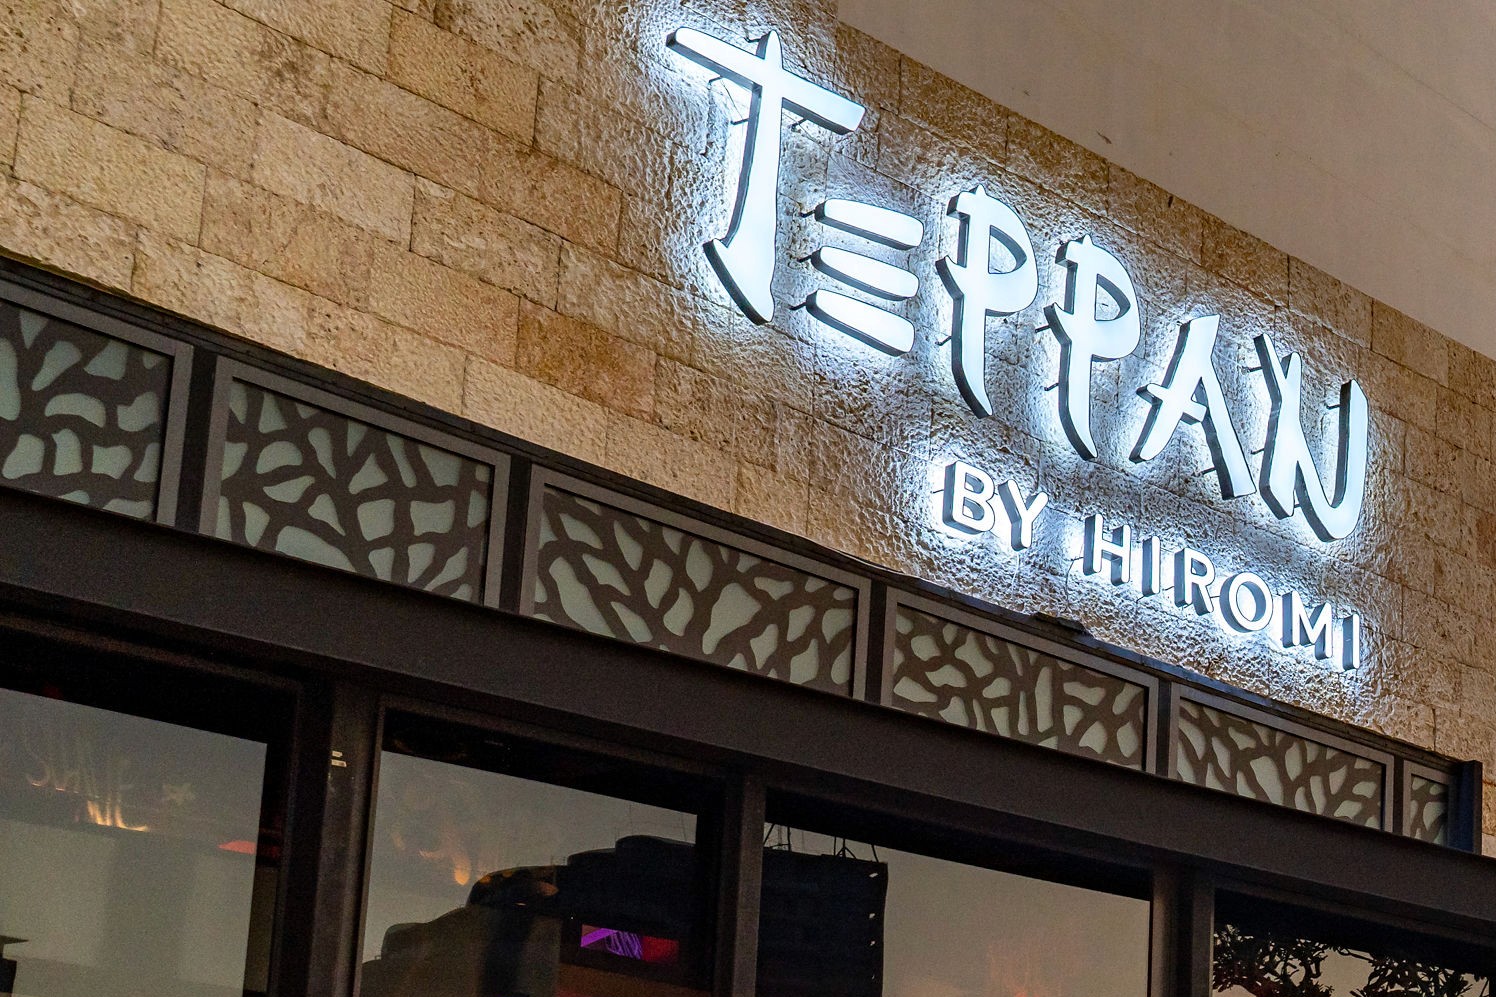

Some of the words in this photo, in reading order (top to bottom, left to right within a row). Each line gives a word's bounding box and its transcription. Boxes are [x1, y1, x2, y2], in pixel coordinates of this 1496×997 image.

[666, 28, 1368, 543] TEPPAN
[943, 460, 1049, 551] BY
[1083, 513, 1360, 670] HIROMI
